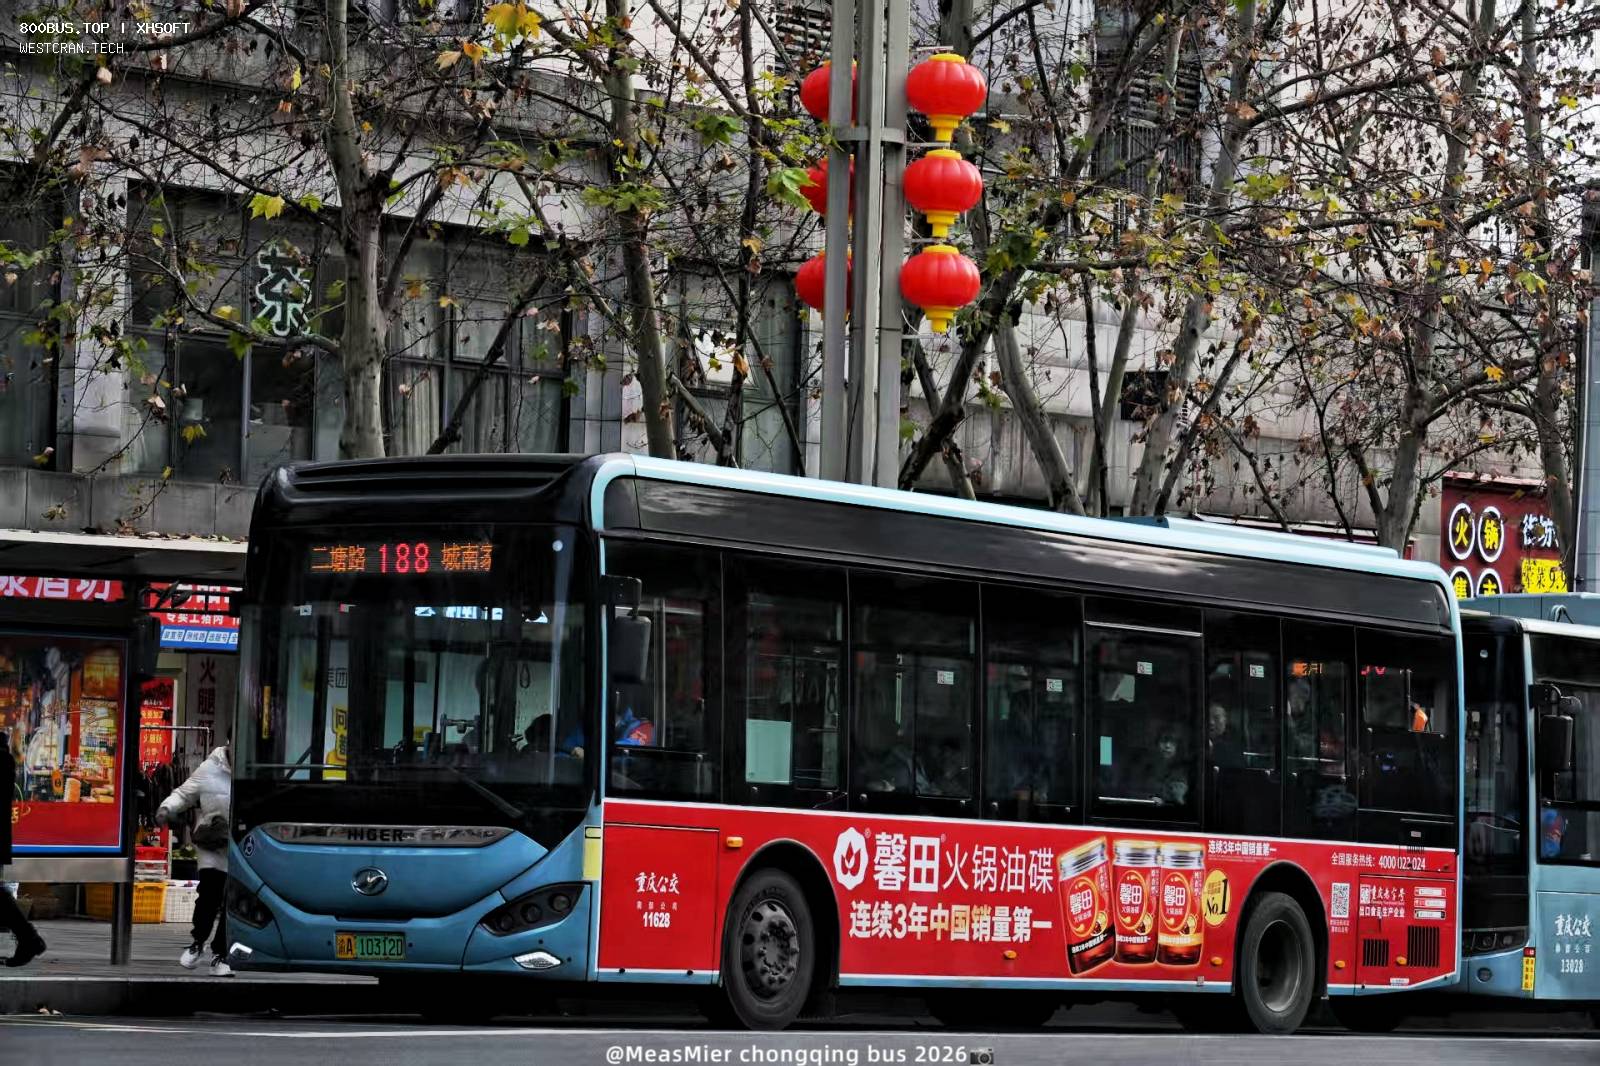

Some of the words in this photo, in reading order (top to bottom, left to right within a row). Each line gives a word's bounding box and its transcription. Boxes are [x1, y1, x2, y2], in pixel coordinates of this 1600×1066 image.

[1454, 515, 1500, 550] 火锅
[311, 545, 366, 572] 二塘路
[379, 543, 431, 573] 188
[347, 828, 404, 842] HIGER
[1208, 839, 1277, 857] 连续3年中国销量第一
[1378, 855, 1397, 869] 4000
[635, 871, 680, 894] 重庆公交
[643, 911, 671, 928] 11628
[849, 900, 1053, 944] 连续3年中国销量第一
[1560, 958, 1584, 973] 13028
